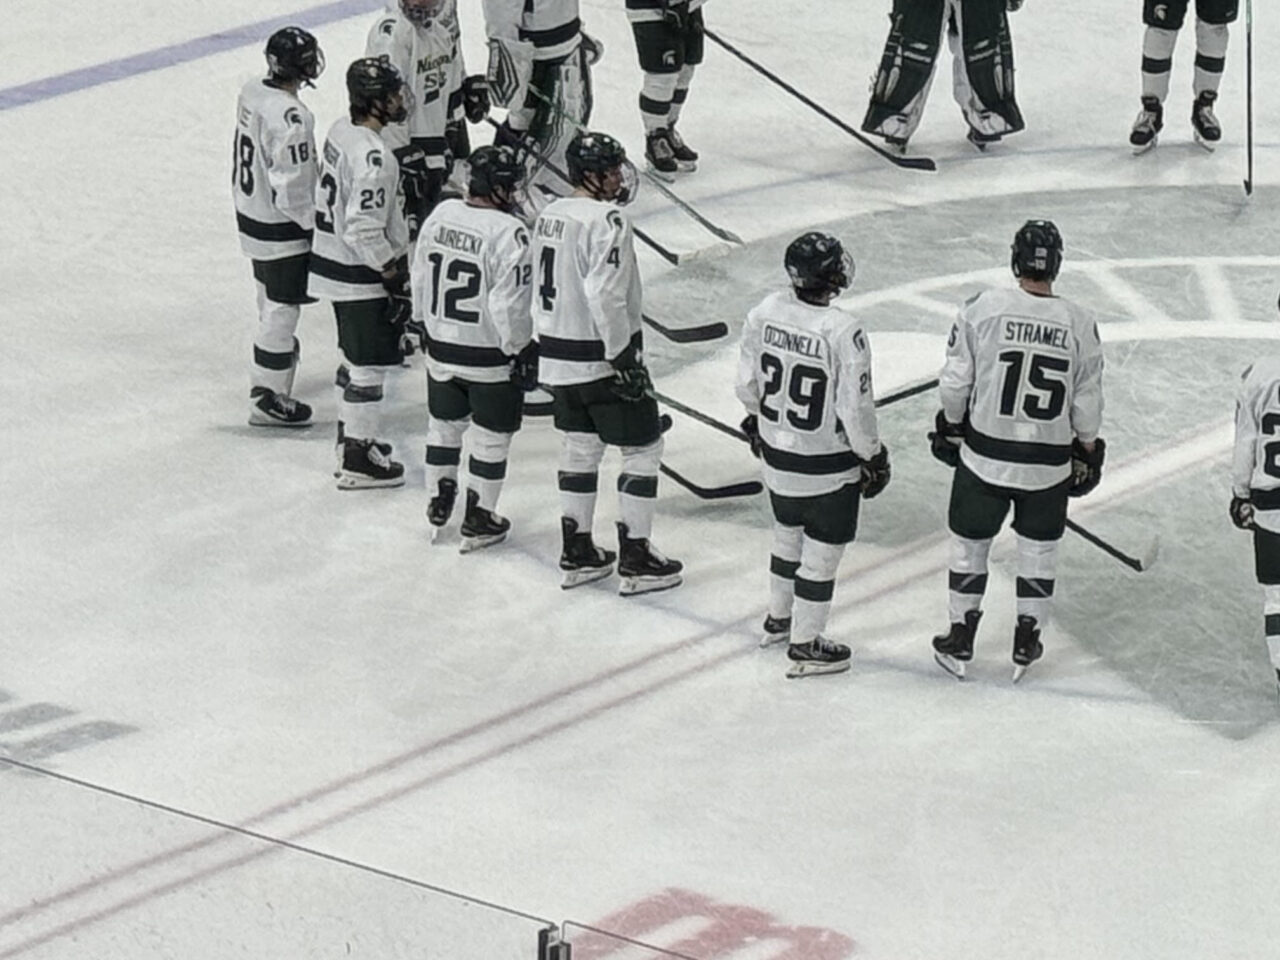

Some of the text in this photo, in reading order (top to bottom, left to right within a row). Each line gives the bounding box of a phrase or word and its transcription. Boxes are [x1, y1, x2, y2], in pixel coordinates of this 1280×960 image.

[288, 141, 310, 165] 18
[360, 187, 385, 211] 23
[434, 226, 483, 255] JURECKI
[607, 246, 621, 269] 4
[427, 252, 482, 324] 12
[512, 264, 532, 288] 12
[1005, 321, 1069, 351] STRAMEL
[760, 352, 829, 432] 29
[999, 350, 1069, 421] 15
